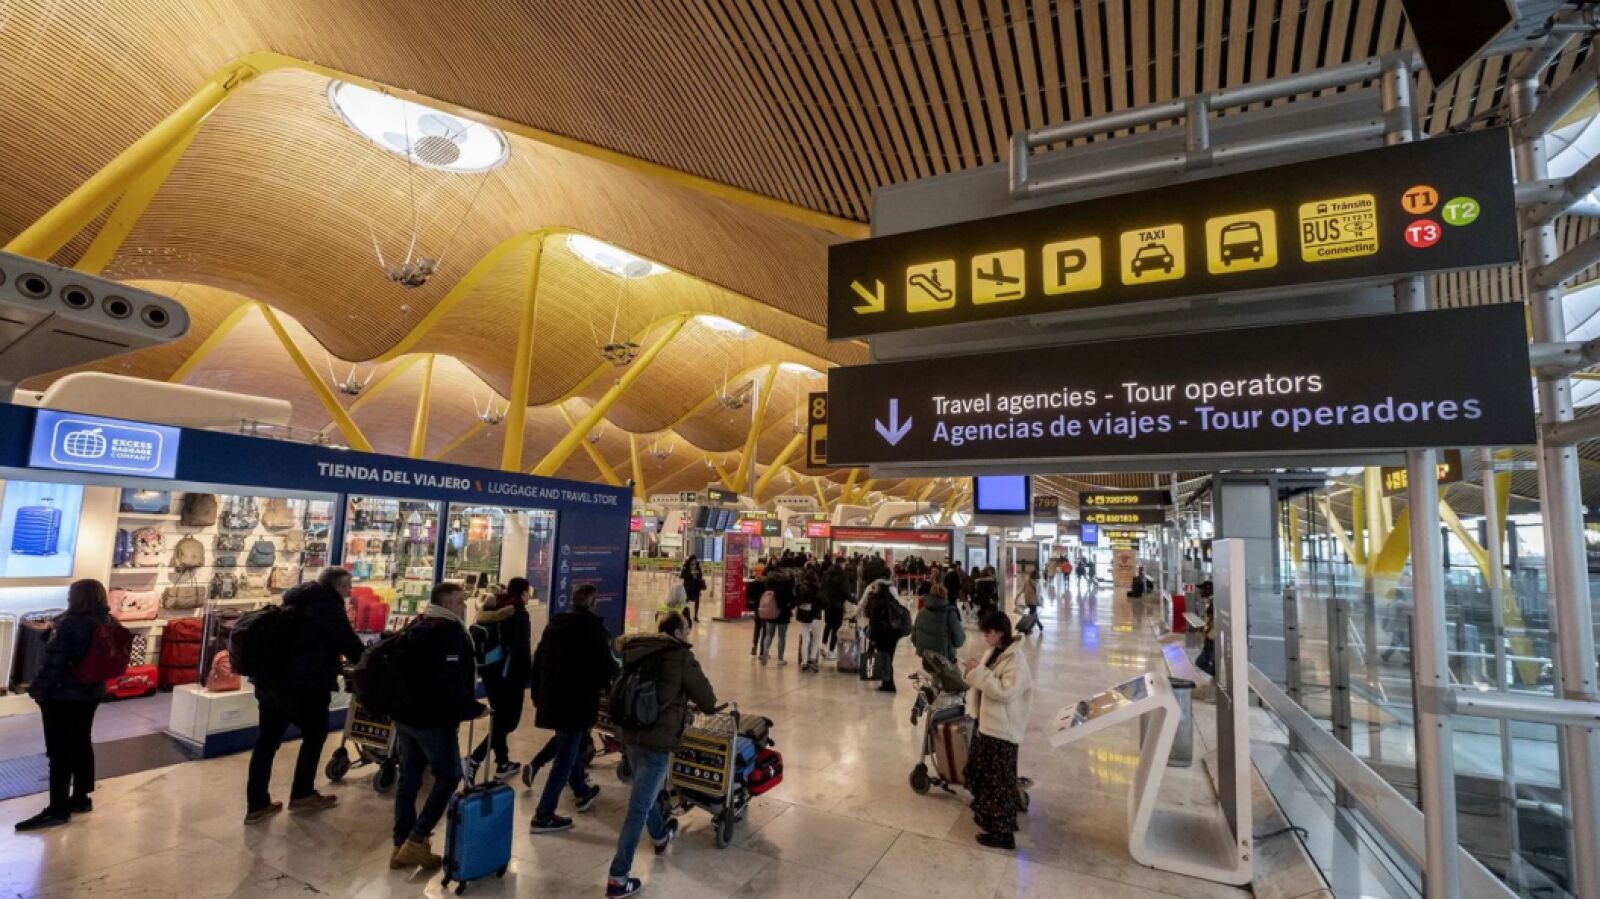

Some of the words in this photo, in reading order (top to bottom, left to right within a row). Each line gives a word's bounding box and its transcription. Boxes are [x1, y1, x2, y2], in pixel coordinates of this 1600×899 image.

[1330, 199, 1373, 211] Tránsito
[1405, 190, 1434, 209] T1
[1446, 202, 1476, 220] T2
[1138, 229, 1166, 242] TAXI
[1303, 219, 1341, 244] BUS
[1408, 225, 1437, 243] T3
[1317, 242, 1376, 257] Connecting
[1056, 249, 1087, 287] P
[932, 393, 990, 415] Travel
[997, 387, 1096, 415] agencies
[1122, 382, 1176, 404] Tour
[1185, 373, 1322, 403] operators
[932, 417, 1045, 446] Agencias
[1050, 414, 1082, 437] de
[1088, 411, 1172, 439] viajes
[1194, 406, 1263, 431] Tour
[1271, 397, 1482, 432] operadores
[111, 438, 153, 450] EXCESS
[110, 453, 151, 461] COMPANY
[317, 461, 379, 482] TIENDA
[382, 469, 411, 485] DEL
[413, 472, 471, 490] VIAJERO
[487, 481, 537, 498] LUGGAGE
[539, 487, 560, 500] AND
[561, 490, 591, 503] TRAVEL
[593, 493, 618, 506] STORE
